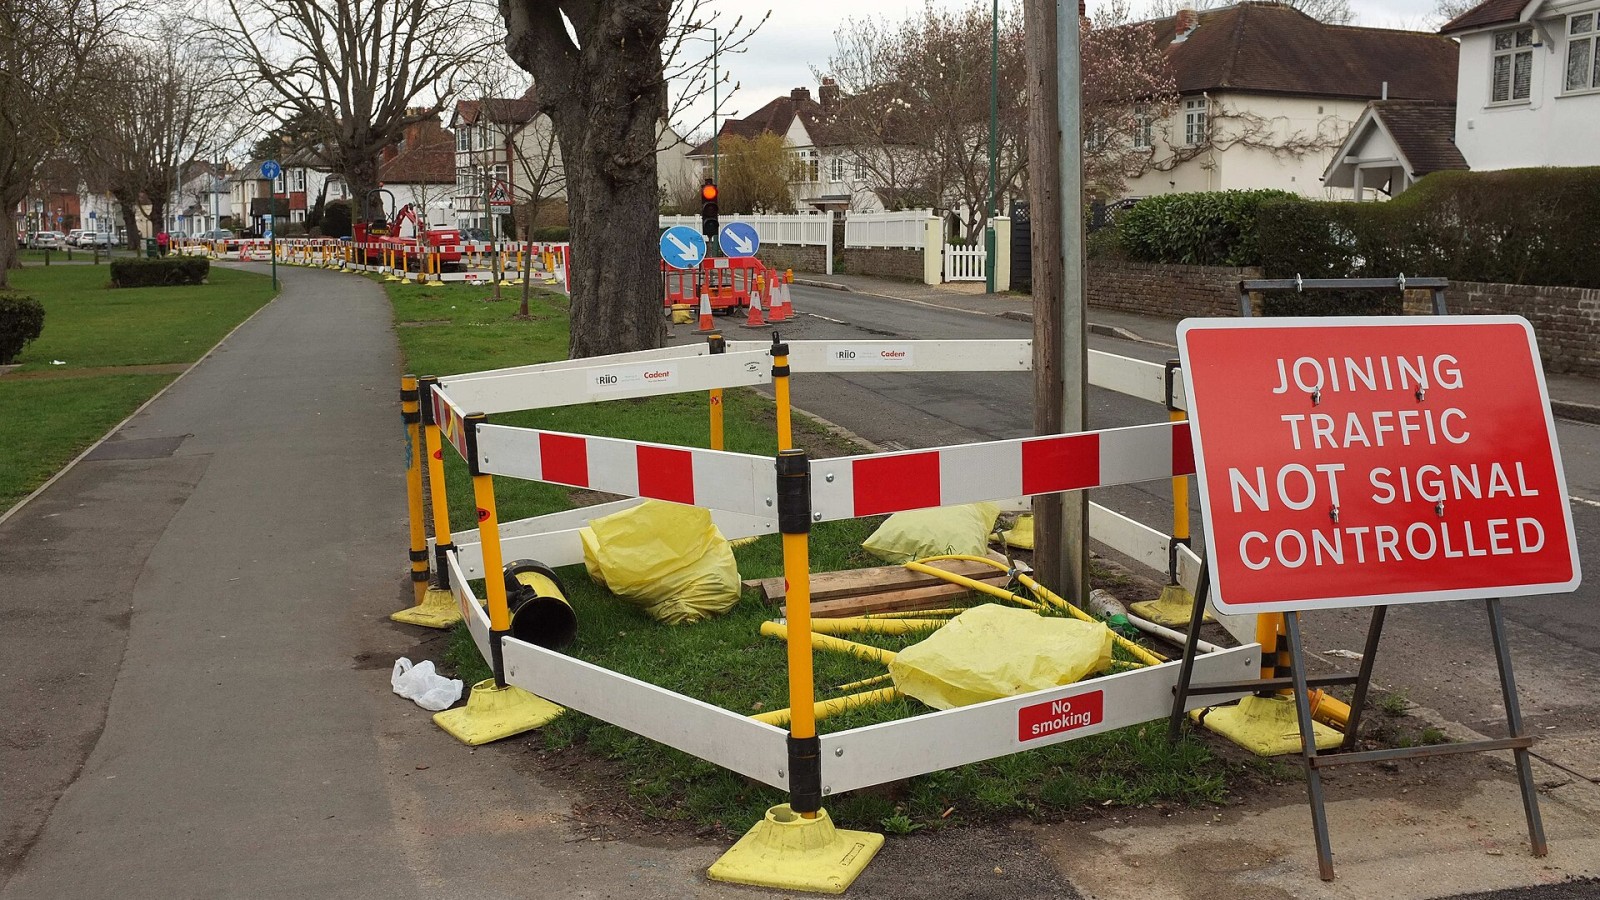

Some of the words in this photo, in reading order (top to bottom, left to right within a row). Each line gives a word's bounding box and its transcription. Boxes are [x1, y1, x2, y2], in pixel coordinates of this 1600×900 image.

[881, 350, 906, 358] Cadent
[643, 370, 670, 379] Cadent
[1272, 354, 1464, 394] JOINING
[1281, 407, 1470, 450] TRAFFIC
[1228, 463, 1346, 513] NOT
[1369, 461, 1539, 505] SIGNAL
[1239, 517, 1546, 571] CONTROLLED
[1032, 711, 1091, 735] smoking
[1052, 700, 1071, 715] No
